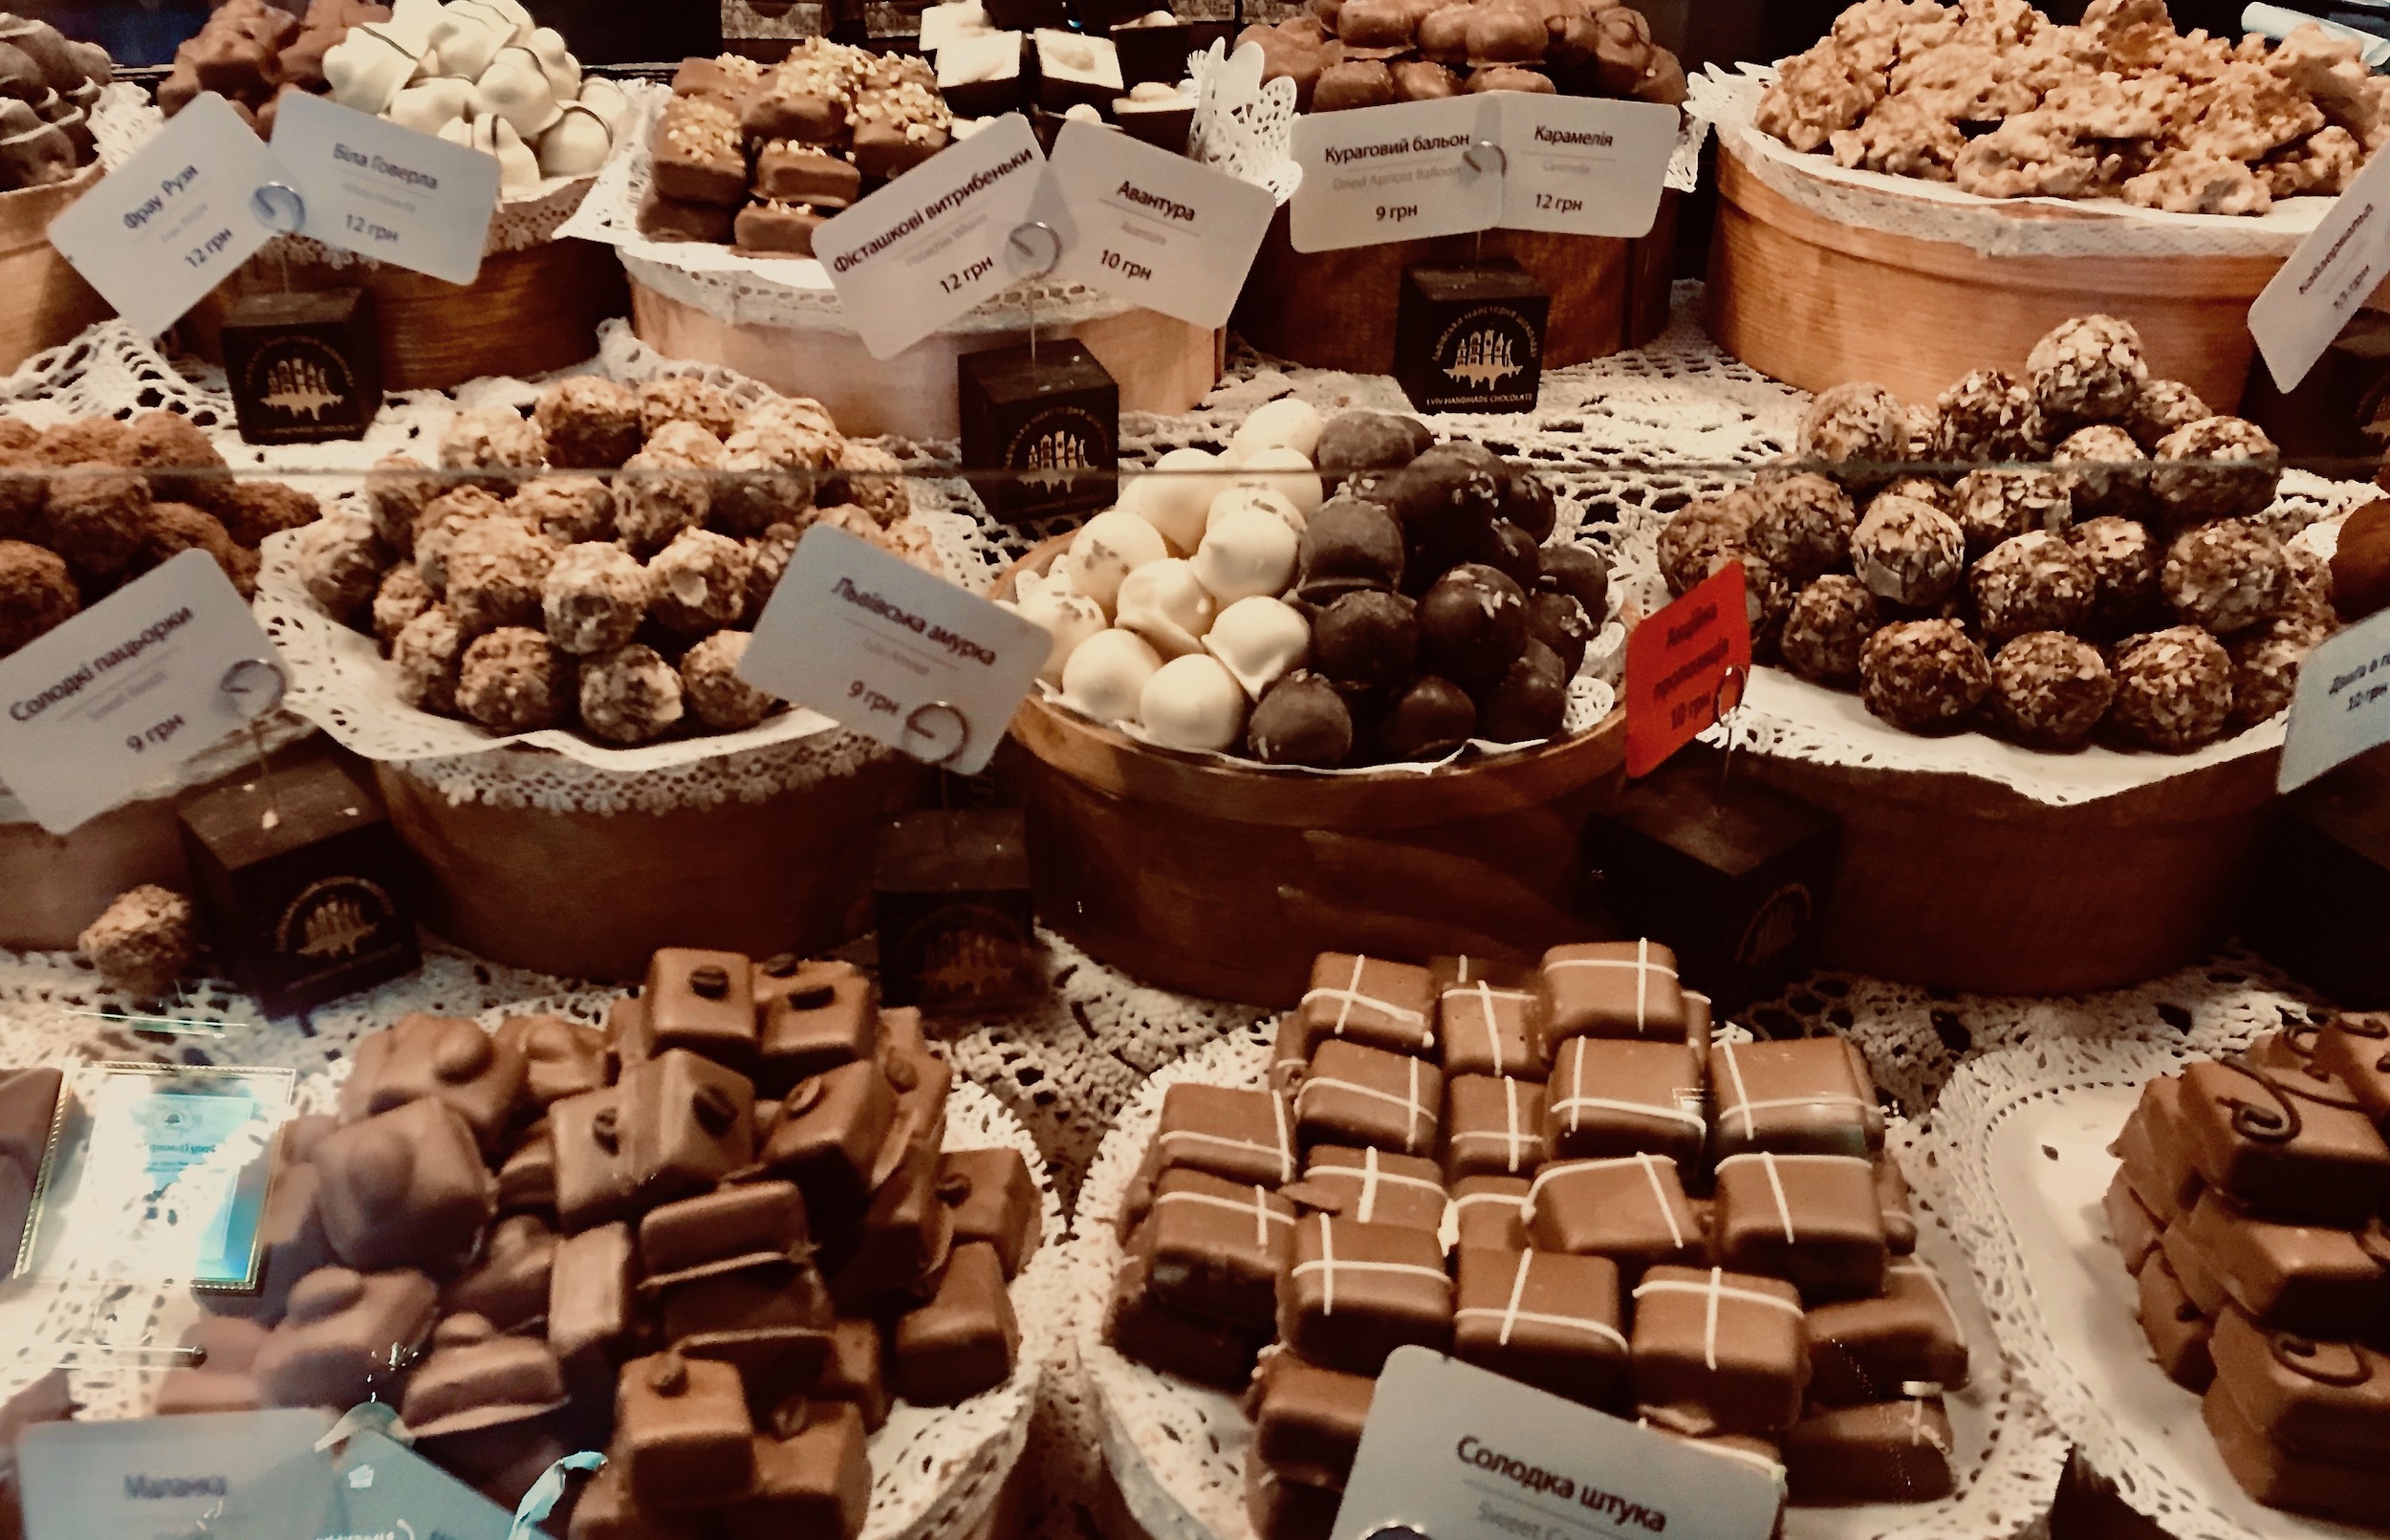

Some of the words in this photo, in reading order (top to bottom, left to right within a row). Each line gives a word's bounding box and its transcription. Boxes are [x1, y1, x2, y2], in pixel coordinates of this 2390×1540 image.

[1325, 137, 1409, 165] Кураговий
[1412, 134, 1469, 152] бальон
[1533, 125, 1614, 147] Карамелія
[333, 142, 367, 167] Біла
[371, 154, 437, 189] Говерла
[123, 195, 163, 228] Фрау
[833, 209, 925, 273] Фісташкові
[924, 148, 1033, 219] витрибеньки
[1116, 181, 1195, 222] Авантура
[1376, 206, 1386, 222] 9
[1390, 205, 1418, 222] грн
[1535, 193, 1553, 209] 12
[1554, 198, 1583, 214] грн
[345, 213, 365, 233] 12
[367, 223, 399, 242] грн
[185, 248, 206, 268] 12
[205, 228, 232, 254] грн
[1100, 249, 1120, 270] 10
[1121, 260, 1152, 281] грн
[940, 272, 962, 294] 12
[963, 256, 994, 281] грн
[1489, 392, 1533, 403] CHOCOLATE
[831, 576, 926, 634] Львівська
[10, 662, 95, 722] Солодкі
[94, 606, 193, 672] пацьорки
[848, 680, 864, 698] 9
[863, 689, 901, 715] грн
[127, 734, 144, 752] 9
[145, 714, 185, 743] грн
[1456, 1435, 1575, 1499] Солодка
[1579, 1484, 1666, 1532] штука
